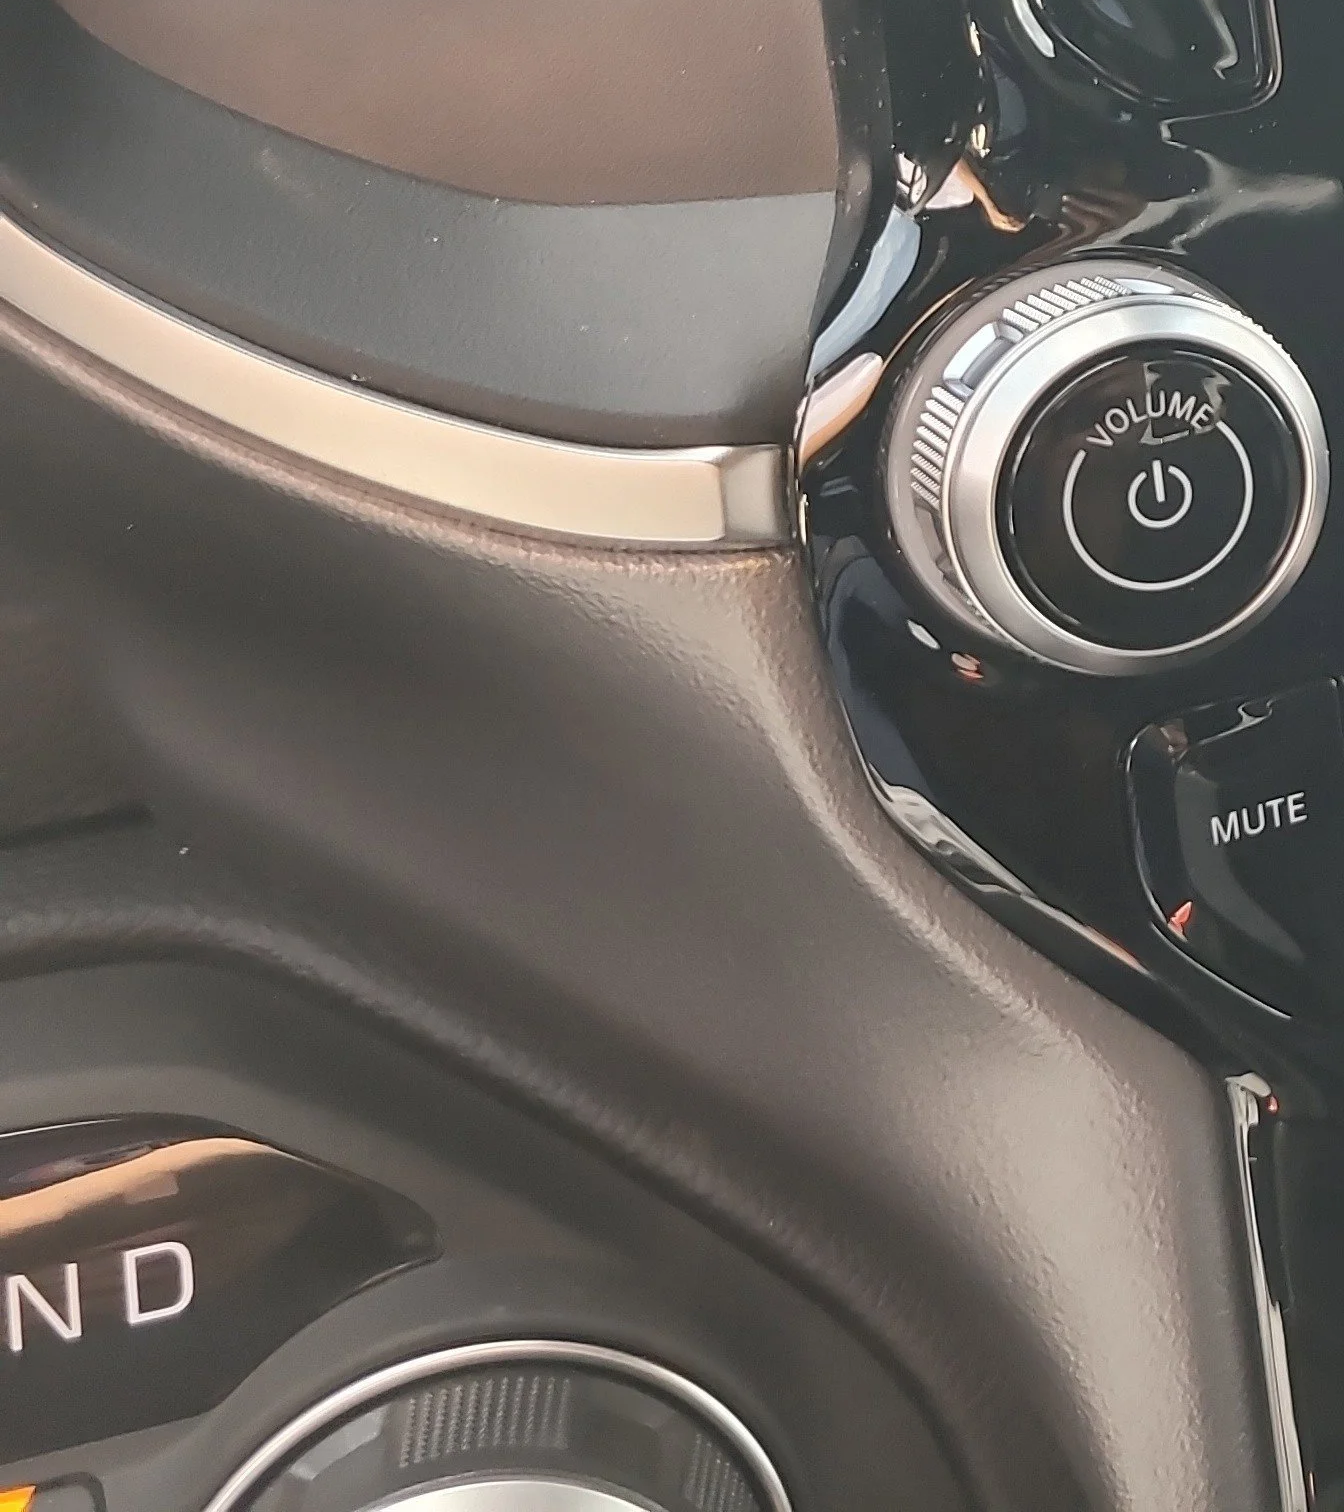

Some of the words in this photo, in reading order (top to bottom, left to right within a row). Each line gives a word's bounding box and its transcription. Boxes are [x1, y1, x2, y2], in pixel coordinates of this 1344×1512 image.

[1086, 391, 1214, 450] VOLUME
[1210, 792, 1308, 847] MUTE
[4, 1263, 83, 1351] N
[122, 1240, 195, 1326] D
